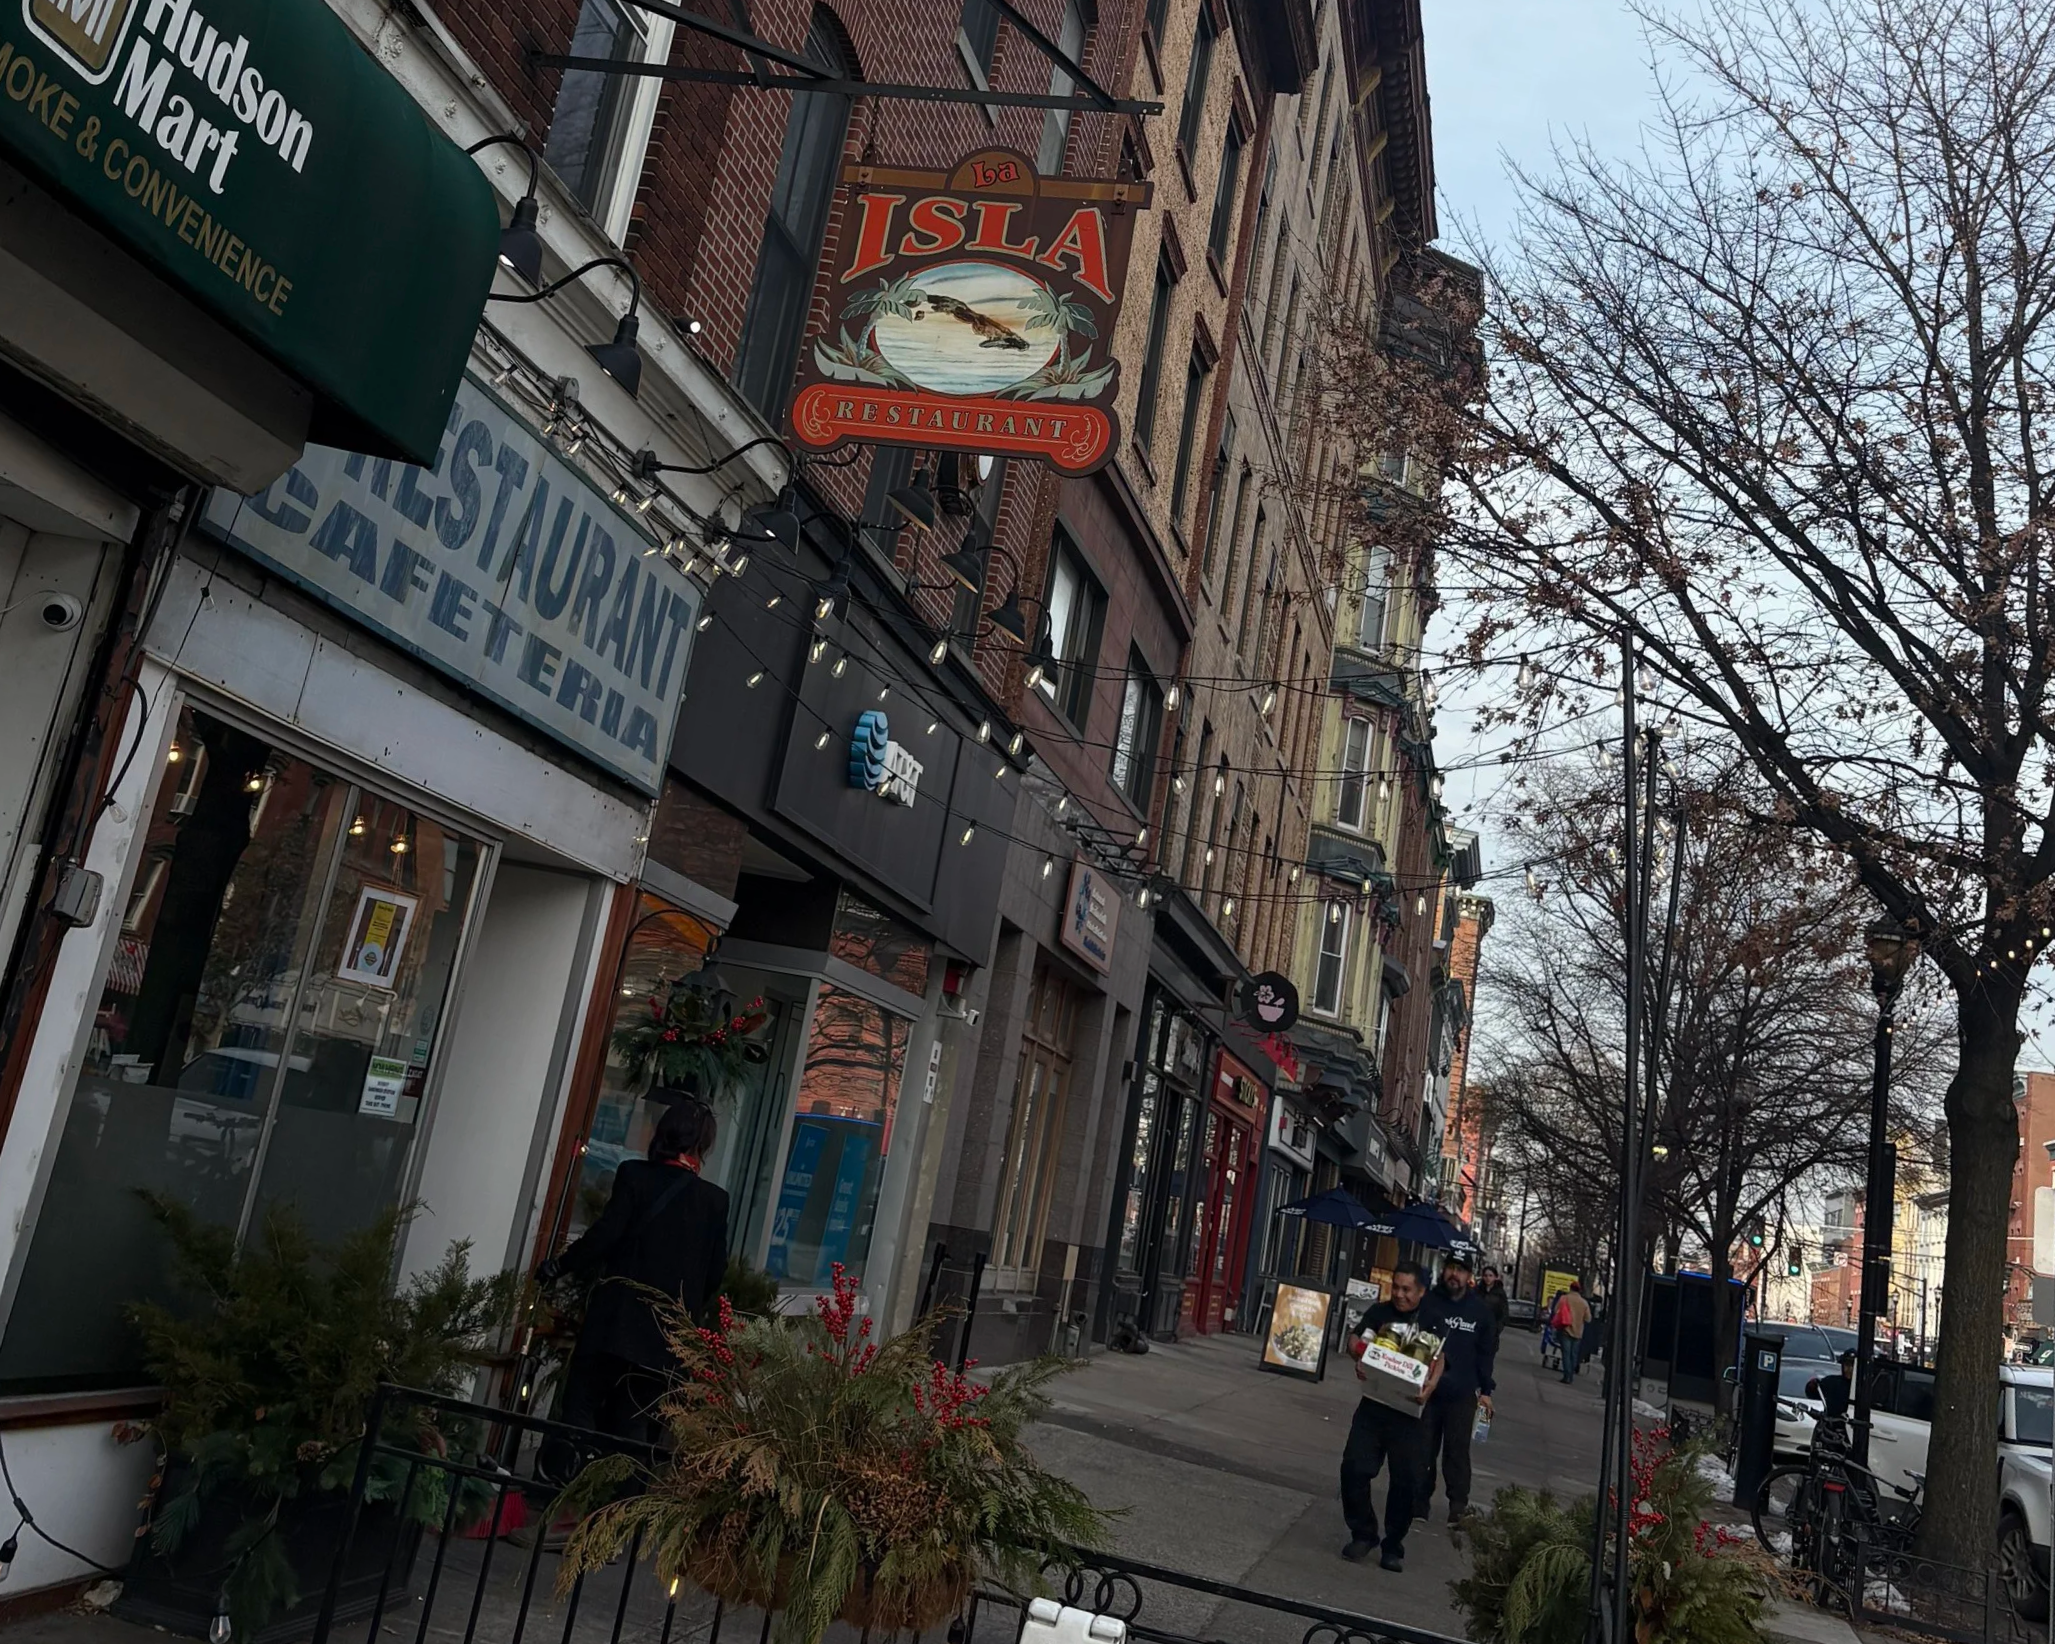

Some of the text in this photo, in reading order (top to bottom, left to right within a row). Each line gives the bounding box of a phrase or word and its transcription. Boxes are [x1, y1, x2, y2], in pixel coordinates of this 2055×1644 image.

[112, 34, 240, 195] Mart
[143, 0, 314, 175] Hudson
[75, 115, 102, 163] &
[102, 137, 294, 317] CONVENIENCE
[840, 192, 1116, 306] ISLA
[834, 398, 1069, 441] RESTAURANT
[243, 464, 660, 766] CAFETERIA
[1763, 1353, 1774, 1368] P
